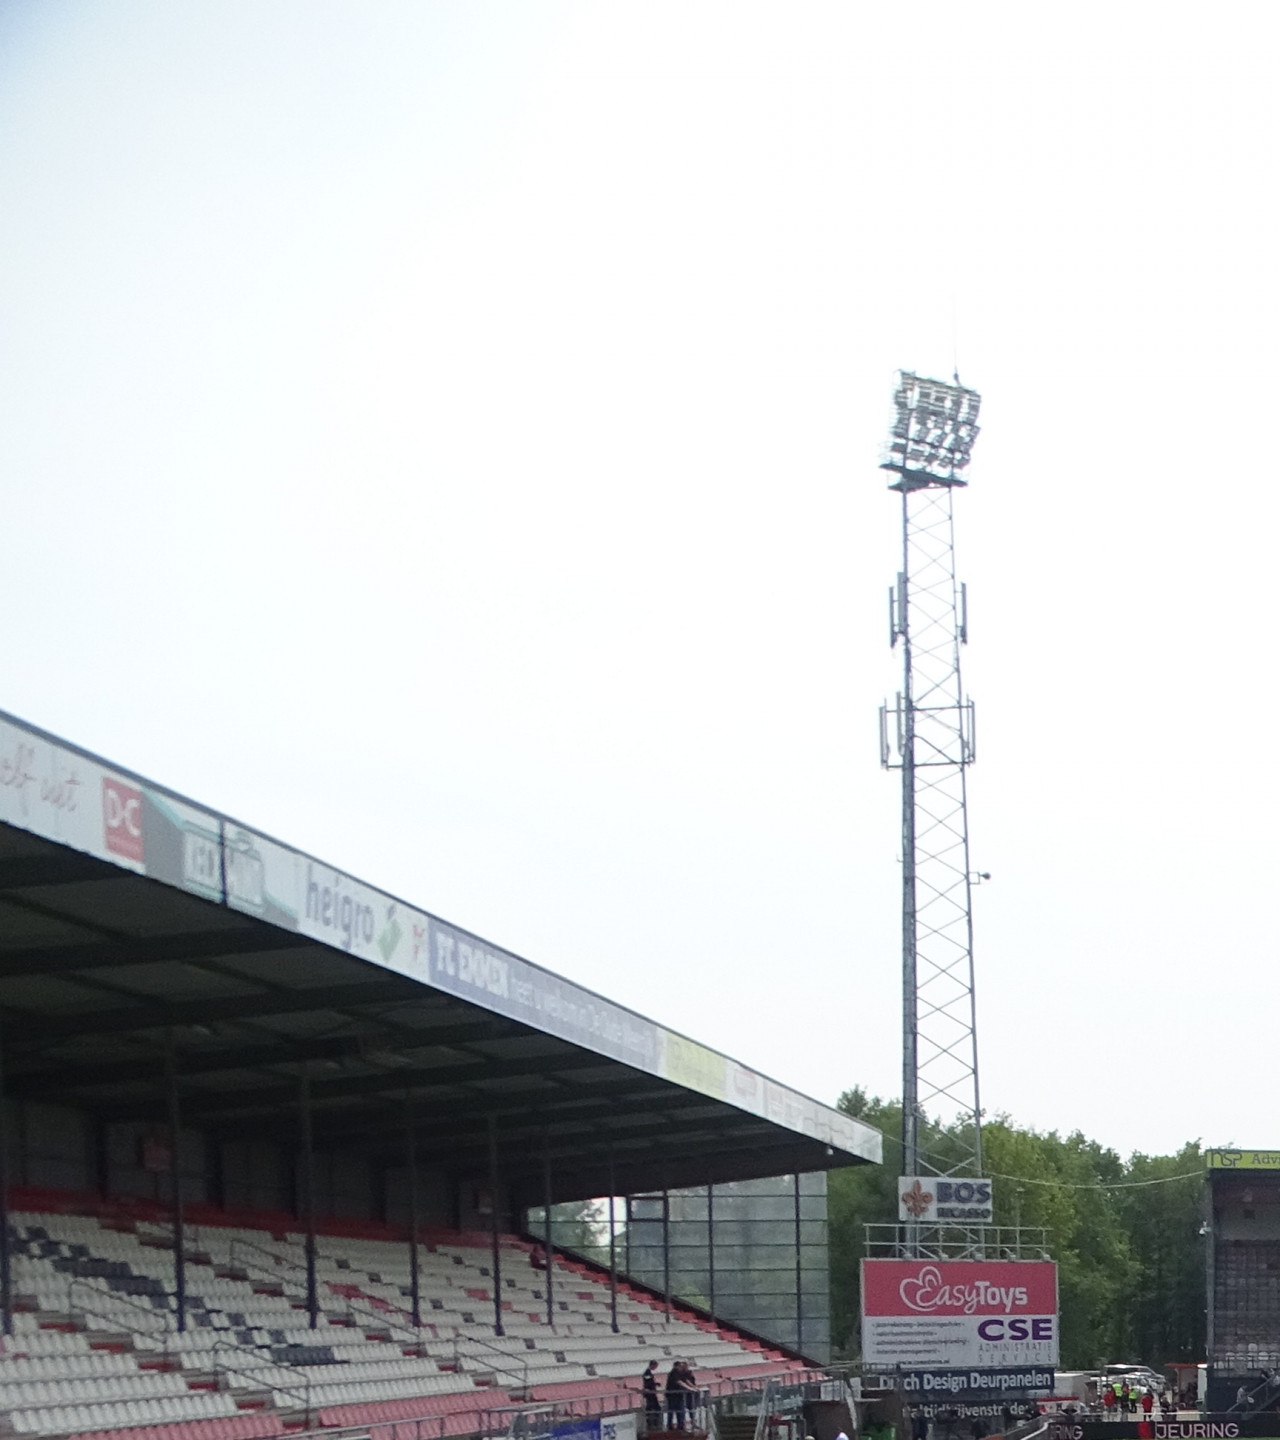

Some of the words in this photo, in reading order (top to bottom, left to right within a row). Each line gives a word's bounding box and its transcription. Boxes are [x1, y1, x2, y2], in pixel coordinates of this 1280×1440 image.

[937, 1182, 991, 1204] BOS
[978, 1319, 1053, 1341] CSE
[923, 1372, 967, 1393] Design
[970, 1368, 1051, 1391] Deurpanelen
[1155, 1421, 1240, 1440] JEURING
